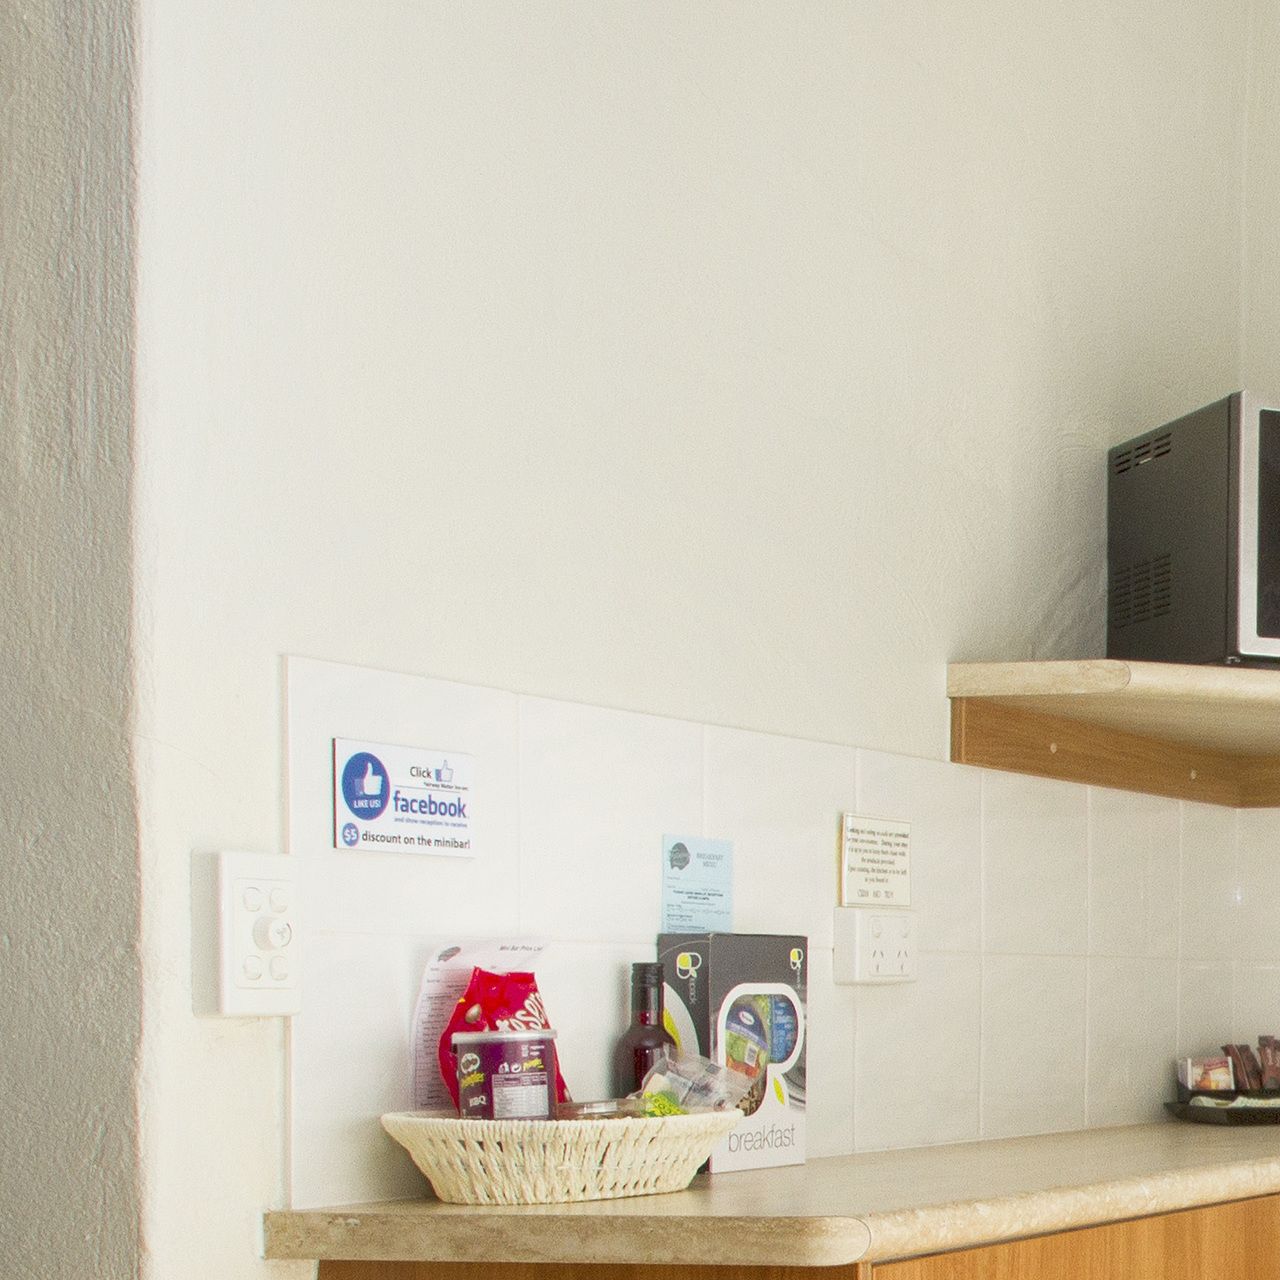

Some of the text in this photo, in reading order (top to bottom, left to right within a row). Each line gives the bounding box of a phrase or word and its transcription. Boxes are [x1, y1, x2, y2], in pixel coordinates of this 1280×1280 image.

[409, 766, 432, 779] Click
[353, 799, 369, 809] LIKE
[393, 790, 467, 819] facebook
[361, 830, 401, 845] discount
[403, 836, 416, 846] on
[417, 835, 432, 848] the
[728, 1123, 796, 1153] breakfast
